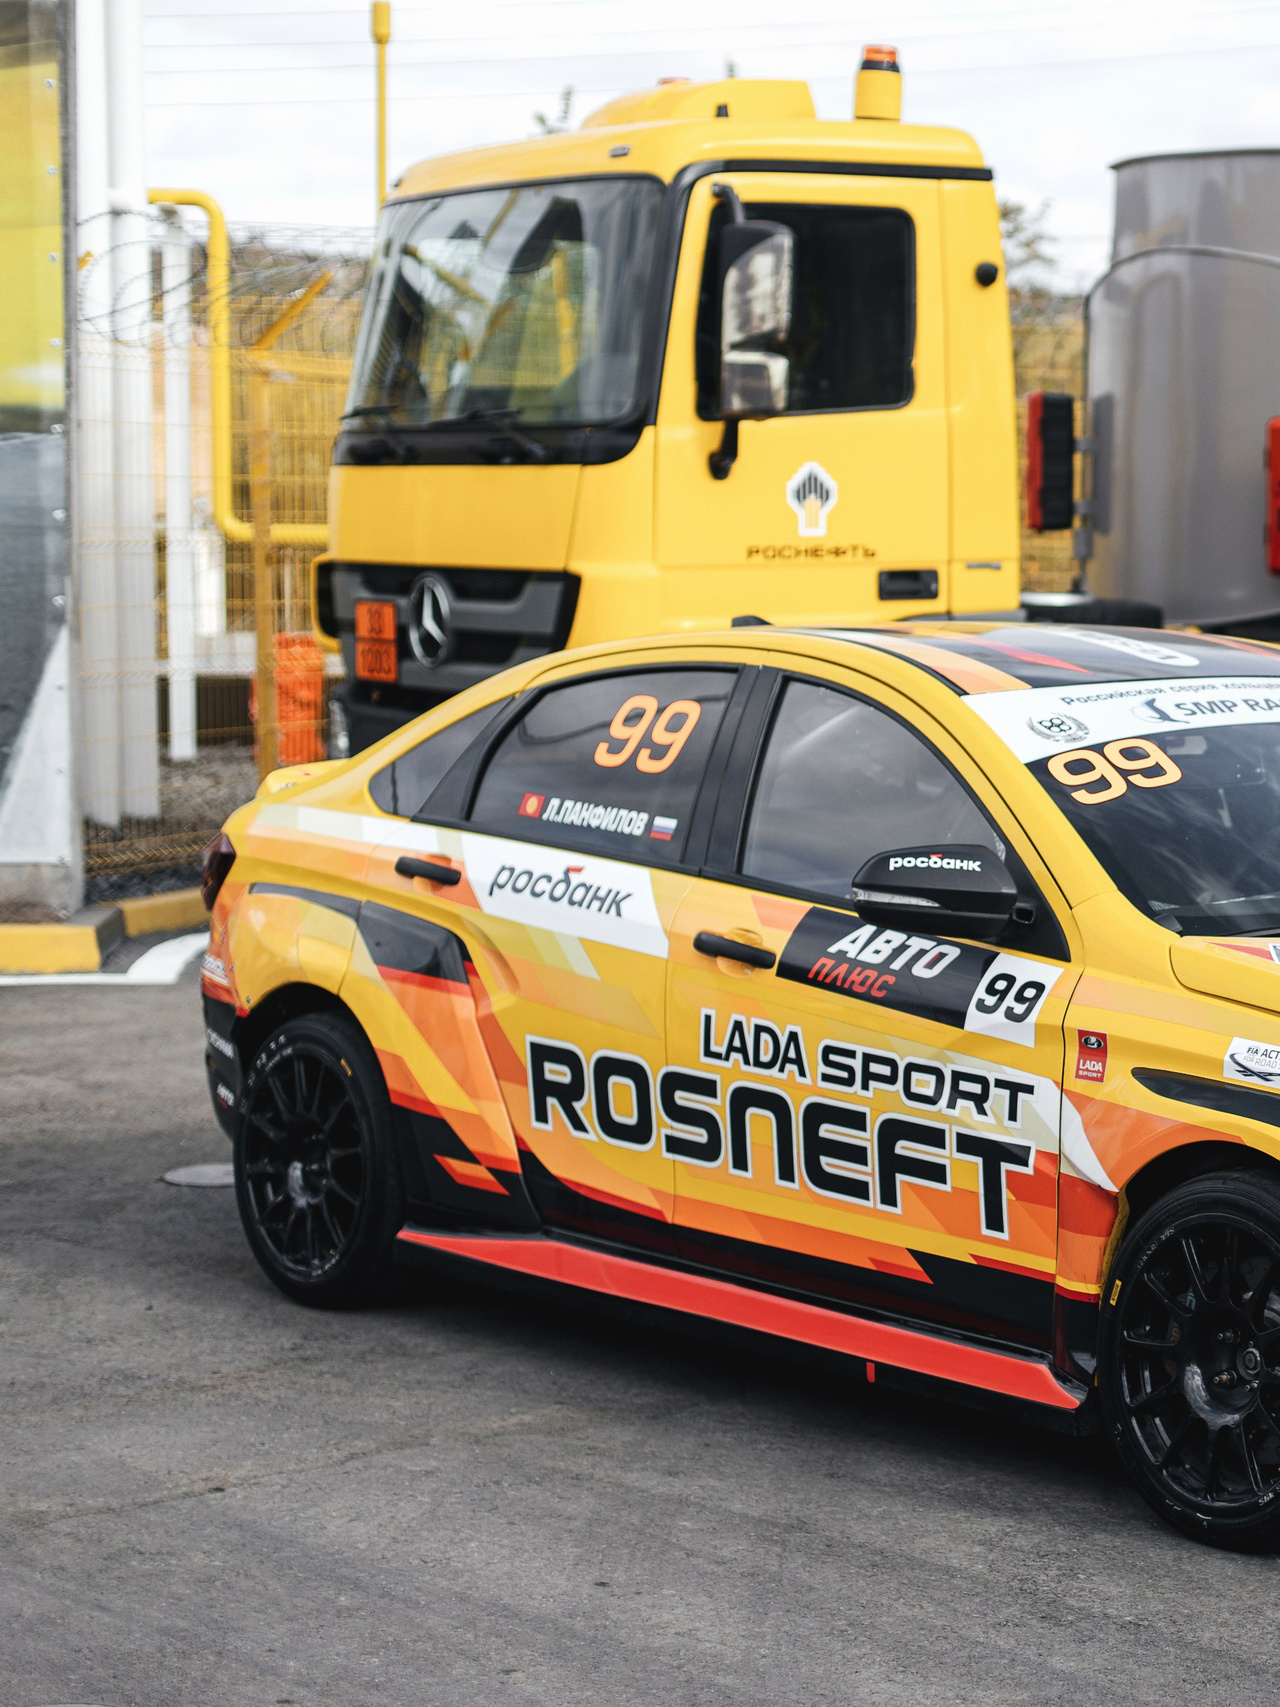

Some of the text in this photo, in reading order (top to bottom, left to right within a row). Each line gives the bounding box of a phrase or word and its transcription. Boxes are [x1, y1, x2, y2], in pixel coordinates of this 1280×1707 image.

[746, 544, 876, 560] РОСНЕФТЬ
[1060, 687, 1166, 705] Российская
[1169, 683, 1218, 694] серия
[1174, 698, 1238, 716] SMP
[594, 694, 702, 774] 99
[1046, 737, 1184, 806] 99
[541, 797, 650, 836] Л.ПАНФИЛОВ
[888, 854, 982, 872] росбанк
[488, 864, 634, 918] росбанк
[826, 923, 962, 979] АВТО
[808, 956, 897, 999] ПЛЮС
[974, 972, 1046, 1024] 99
[702, 1009, 1038, 1126] LADA SPORT
[1078, 1069, 1102, 1079] SPORT
[1079, 1058, 1103, 1072] LADA
[1243, 1055, 1257, 1064] FOR
[1255, 1058, 1278, 1069] ROAD
[526, 1036, 1036, 1240] ROSNEFT
